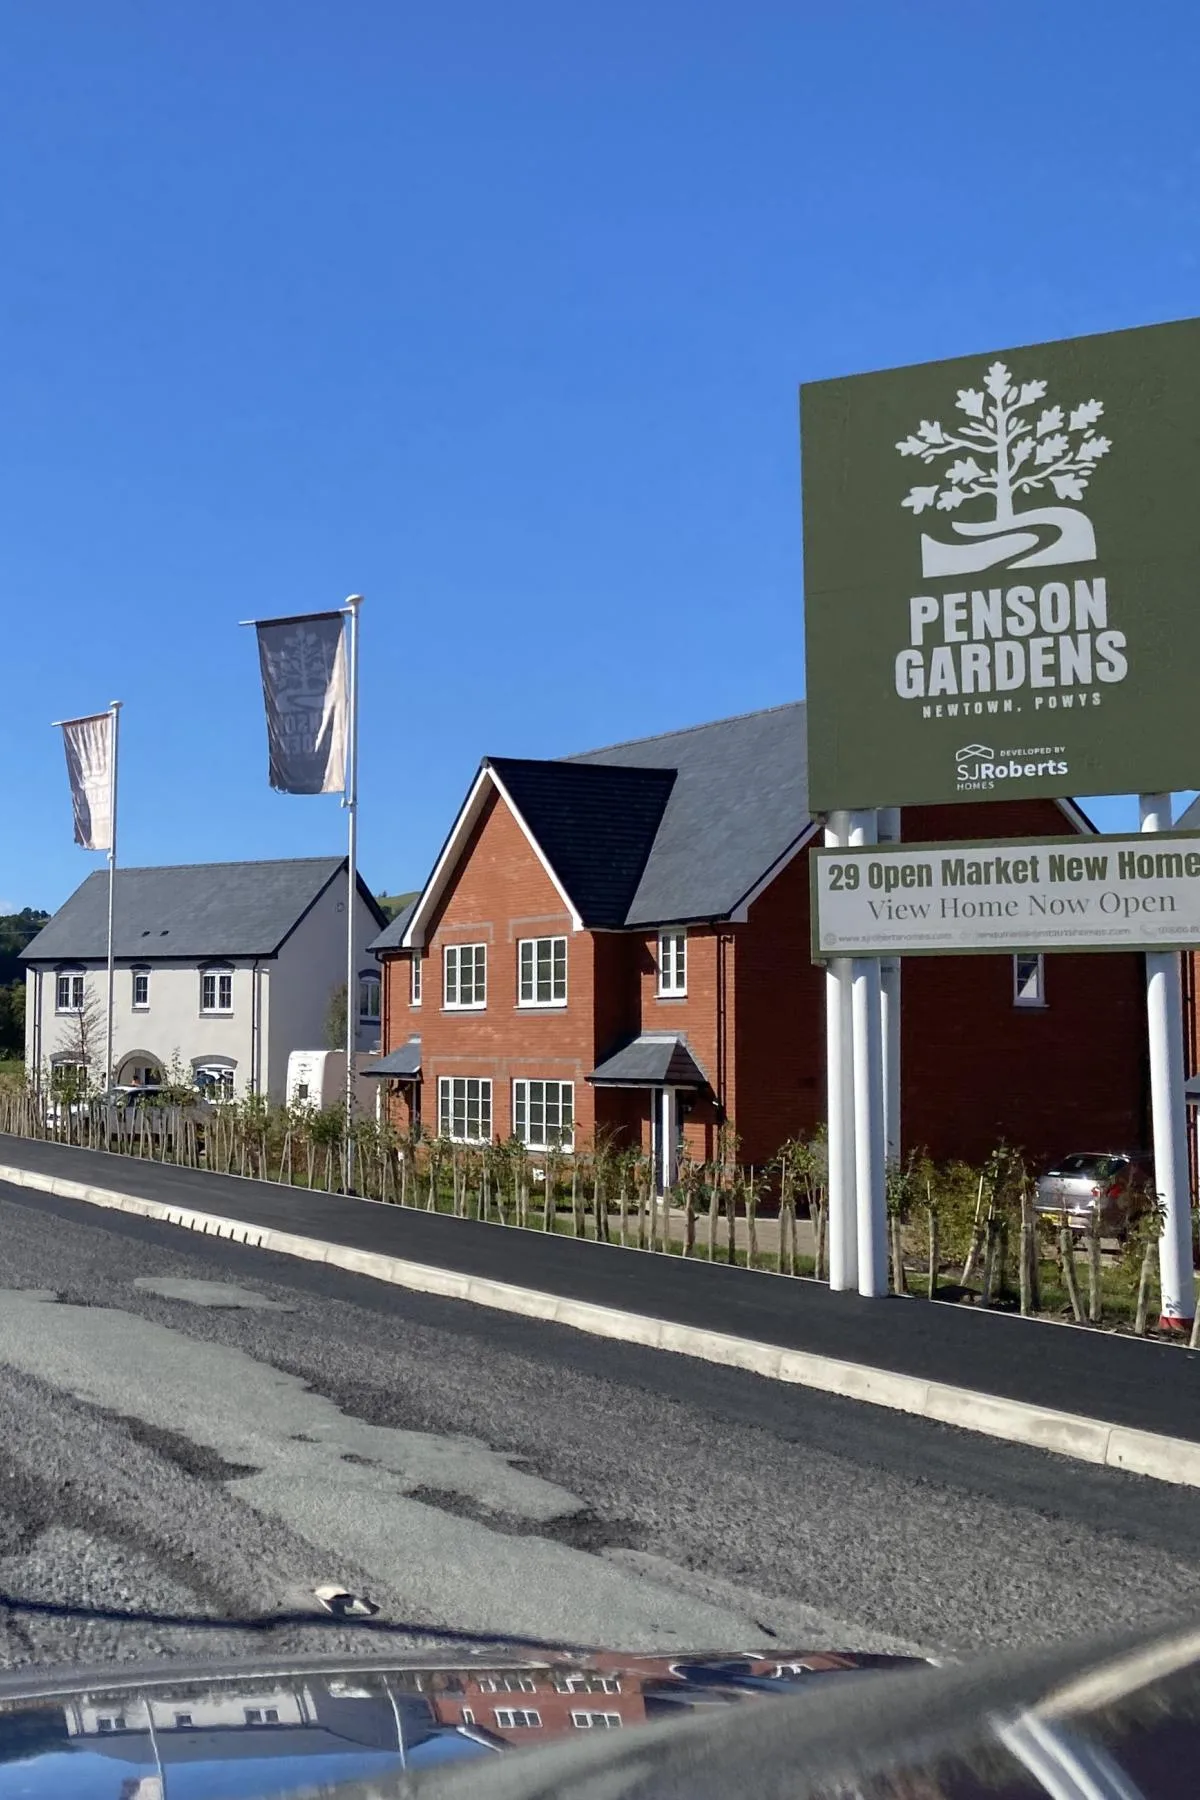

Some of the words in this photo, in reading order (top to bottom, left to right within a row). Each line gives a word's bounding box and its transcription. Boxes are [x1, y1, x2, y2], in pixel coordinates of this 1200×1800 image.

[909, 577, 1107, 646] PENSON
[895, 630, 1128, 699] GARDENS
[1034, 692, 1102, 710] POWYS
[1000, 747, 1052, 757] DEVELOPED
[1054, 746, 1066, 754] BY
[957, 781, 995, 791] HOMES
[828, 863, 860, 891] 29
[868, 862, 933, 893] Open
[941, 855, 1040, 887] Market
[1048, 854, 1108, 882] New
[867, 899, 931, 920] View
[940, 897, 1018, 918] Home
[1029, 895, 1090, 916] Now
[1099, 891, 1176, 918] Open
